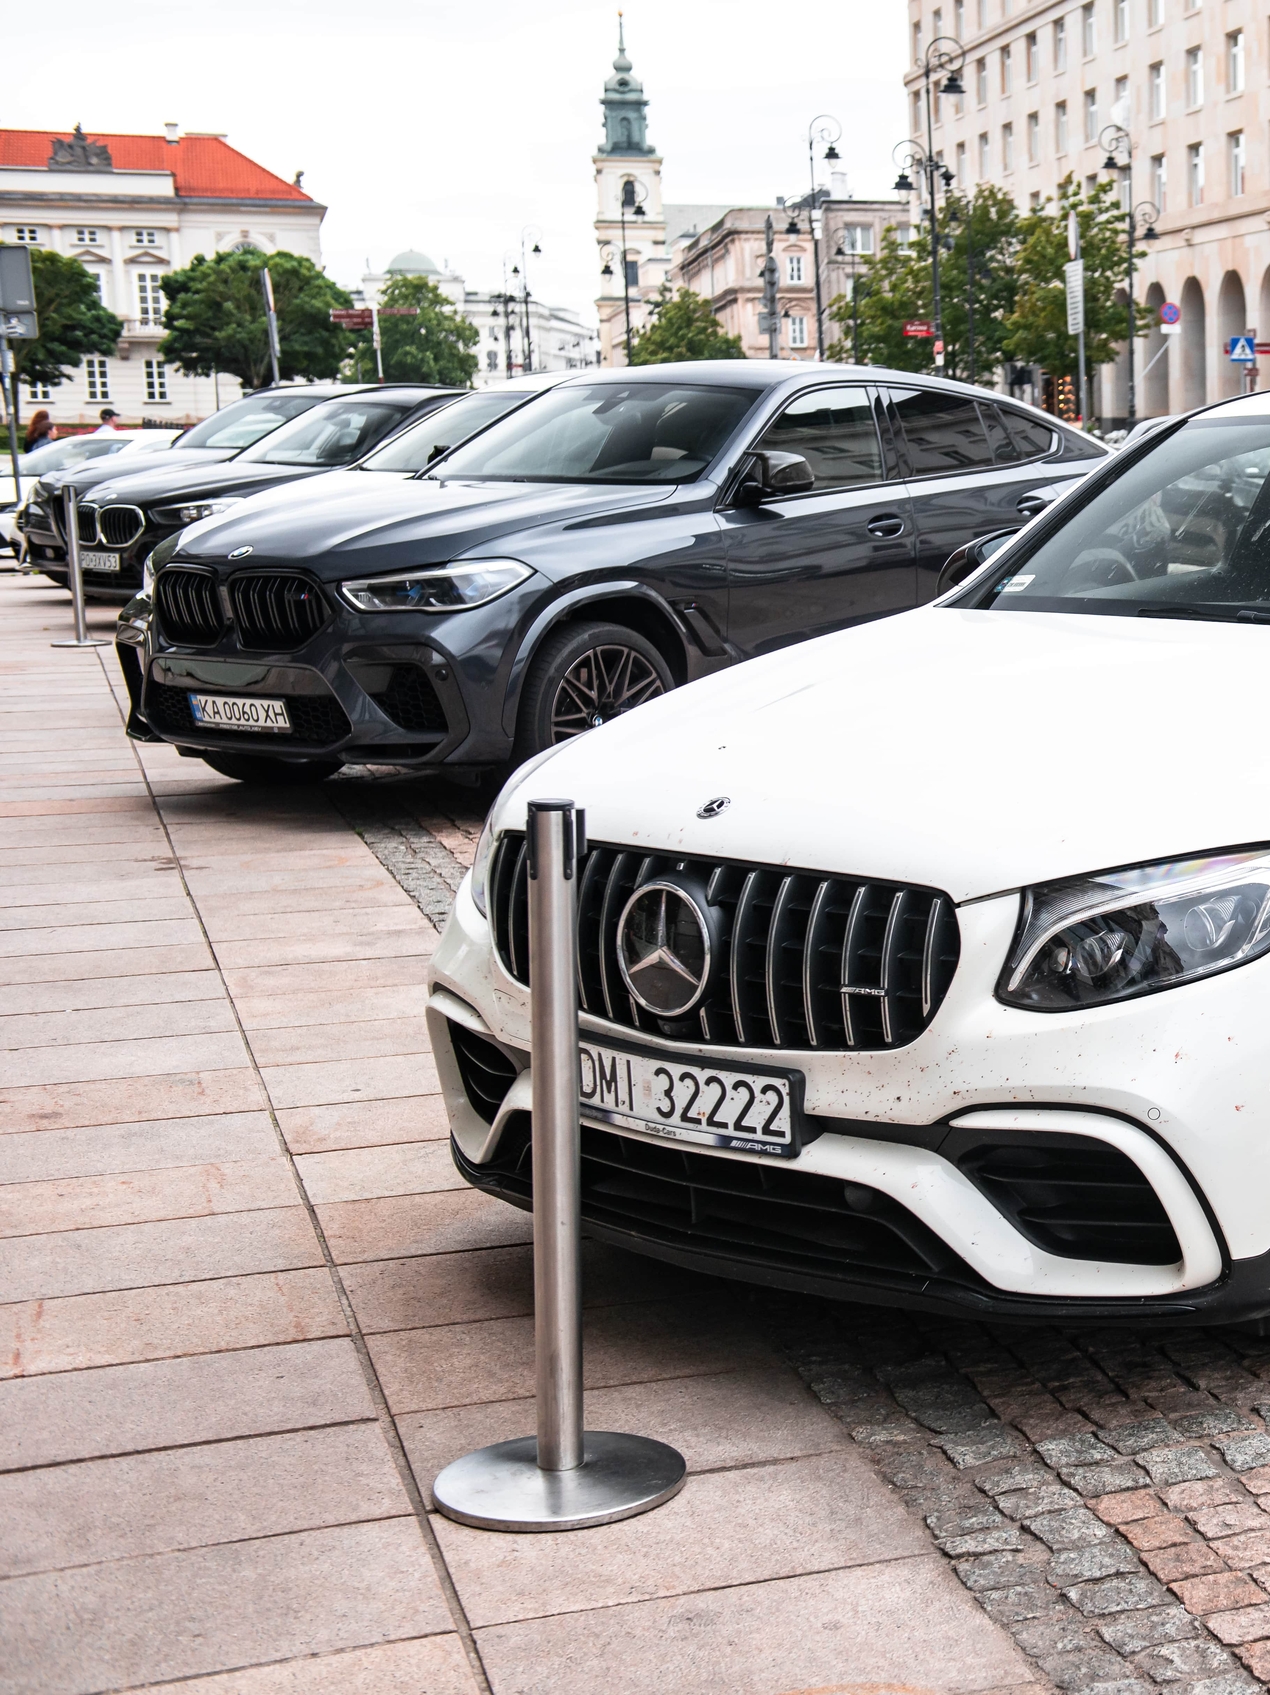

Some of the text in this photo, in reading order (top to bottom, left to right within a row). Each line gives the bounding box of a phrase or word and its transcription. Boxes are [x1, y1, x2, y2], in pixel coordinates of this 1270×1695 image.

[199, 699, 288, 725] KA 0060 XH
[579, 1046, 786, 1139] DMI 32222
[644, 1123, 677, 1138] Duda-Cars
[746, 1143, 782, 1154] AMG
